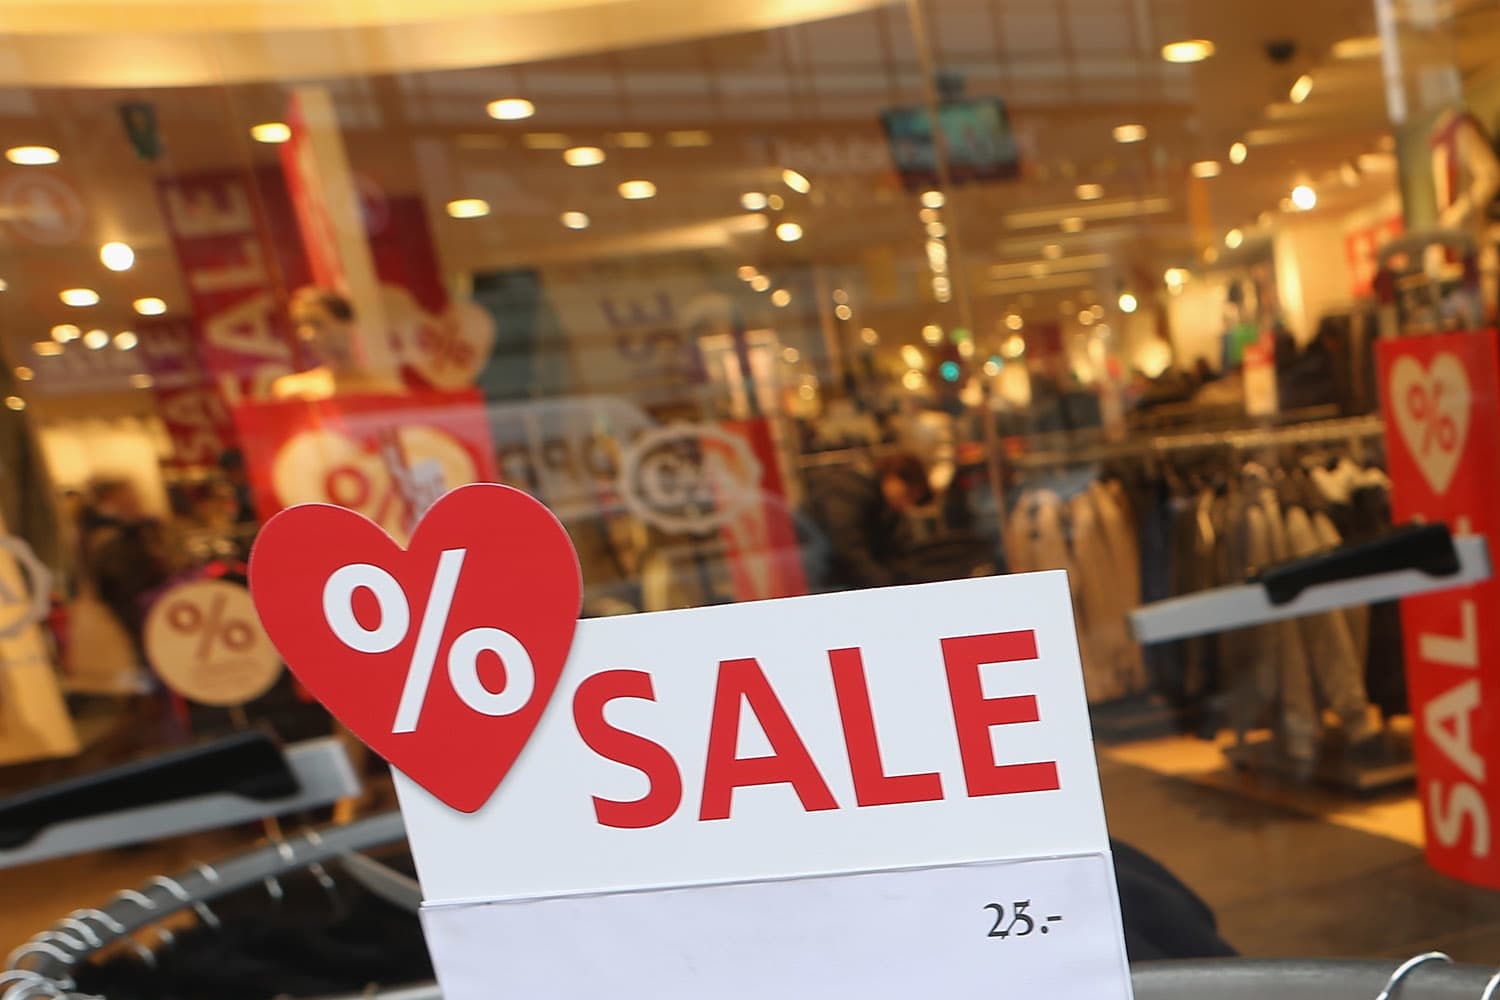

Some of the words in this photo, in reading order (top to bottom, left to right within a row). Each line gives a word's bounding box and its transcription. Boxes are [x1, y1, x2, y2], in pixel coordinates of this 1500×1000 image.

[323, 548, 535, 734] %
[572, 629, 1060, 829] SALE
[1417, 514, 1491, 858] SAL
